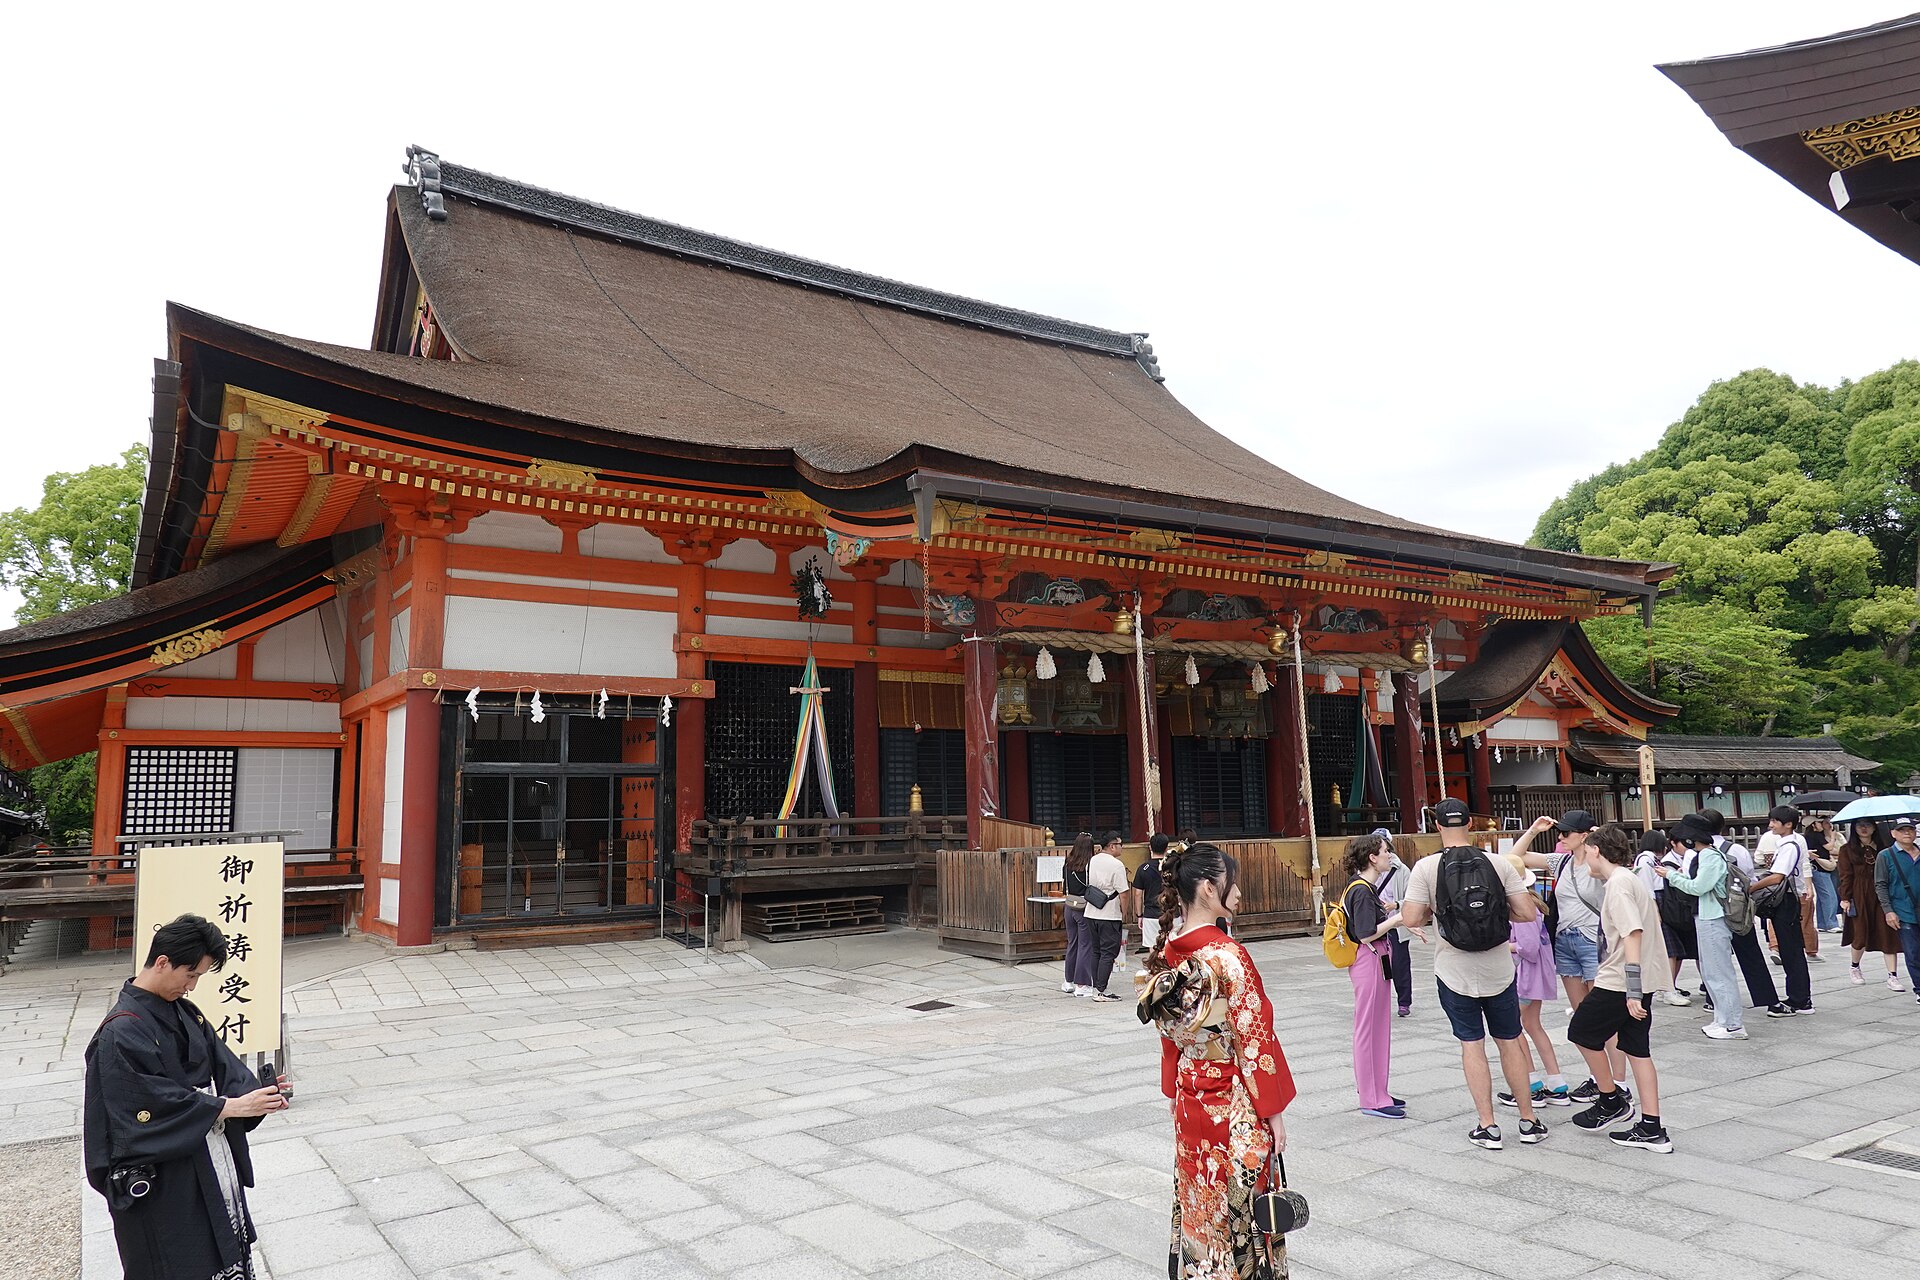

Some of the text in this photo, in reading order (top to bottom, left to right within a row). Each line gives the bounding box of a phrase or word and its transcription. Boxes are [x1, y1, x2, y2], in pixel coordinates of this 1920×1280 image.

[218, 855, 254, 1044] 御祈祷受付
